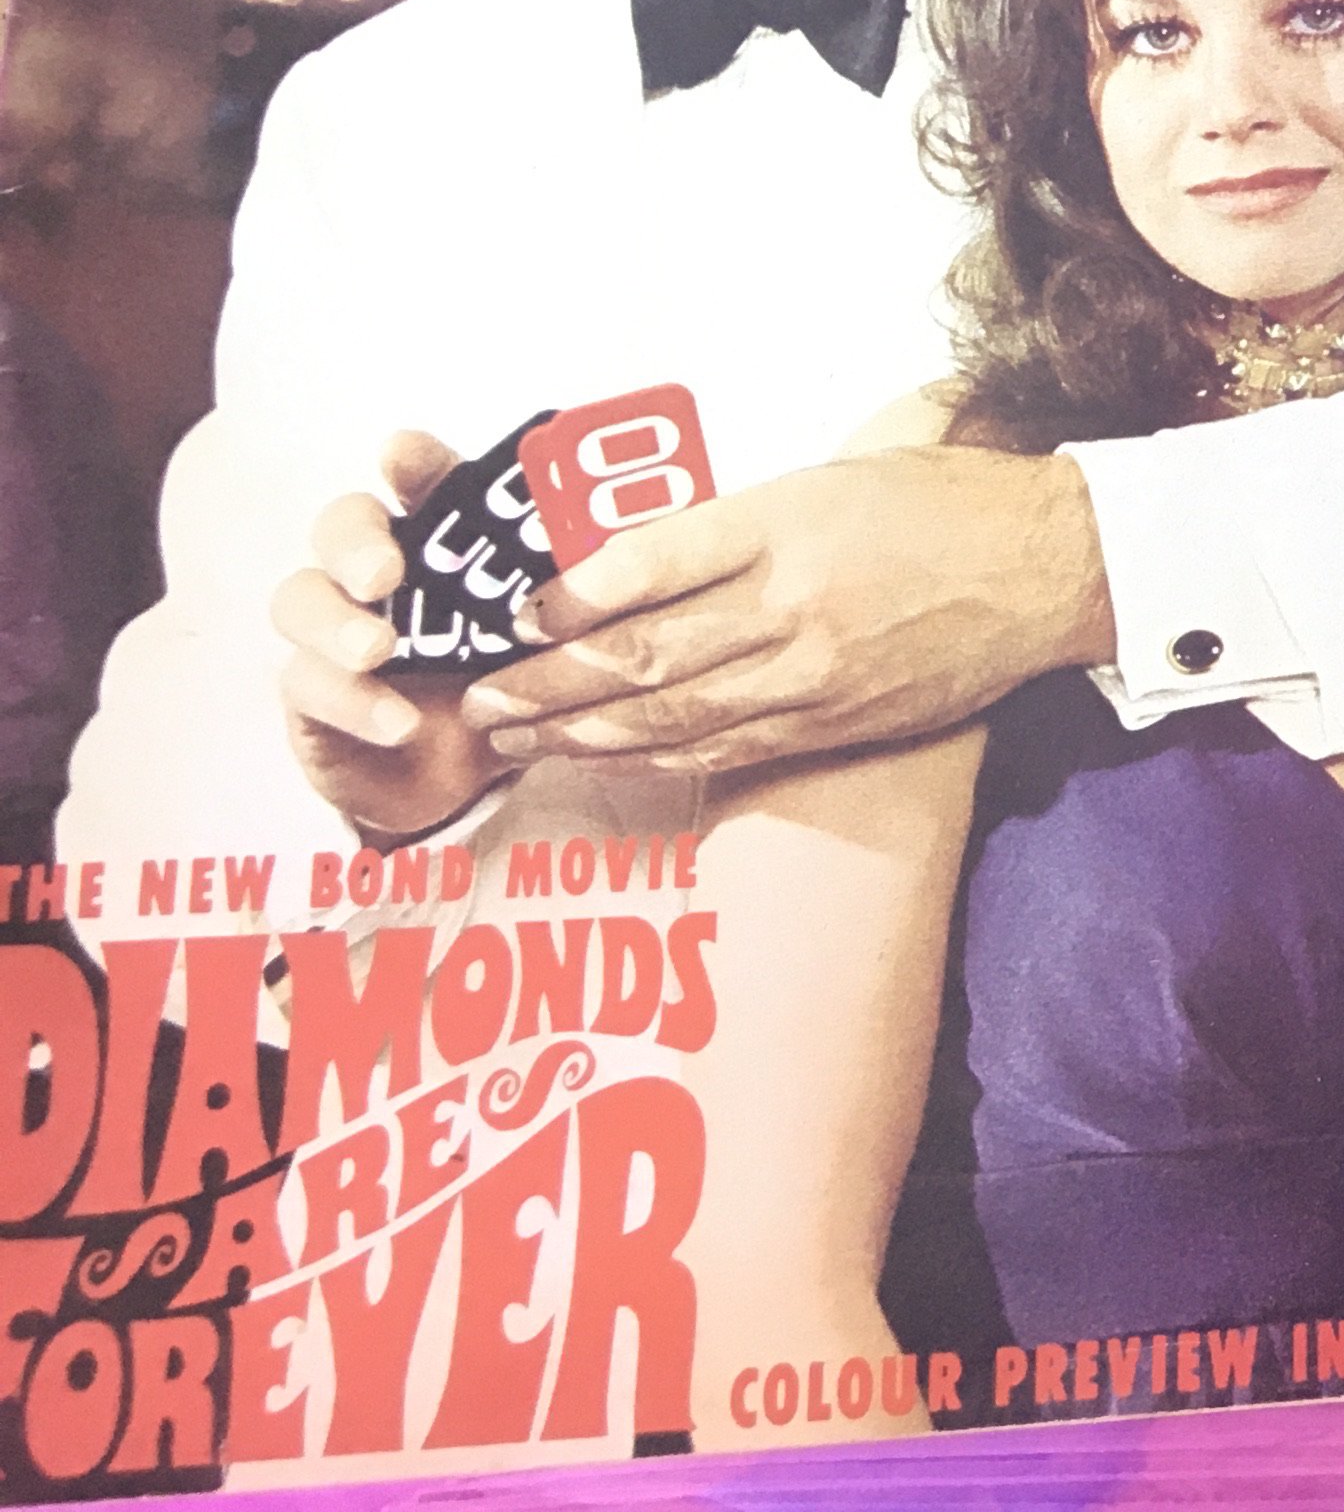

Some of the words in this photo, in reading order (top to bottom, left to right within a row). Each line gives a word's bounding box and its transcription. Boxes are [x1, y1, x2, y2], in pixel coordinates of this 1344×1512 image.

[0, 861, 106, 924] THE
[138, 854, 277, 917] NEW
[310, 845, 474, 909] BOND
[505, 833, 699, 898] MOVIE
[0, 910, 718, 1225] DIAMONDS
[165, 1073, 471, 1310] ARE
[729, 1351, 963, 1431] COLOUR
[995, 1326, 1259, 1409] PREVIEW
